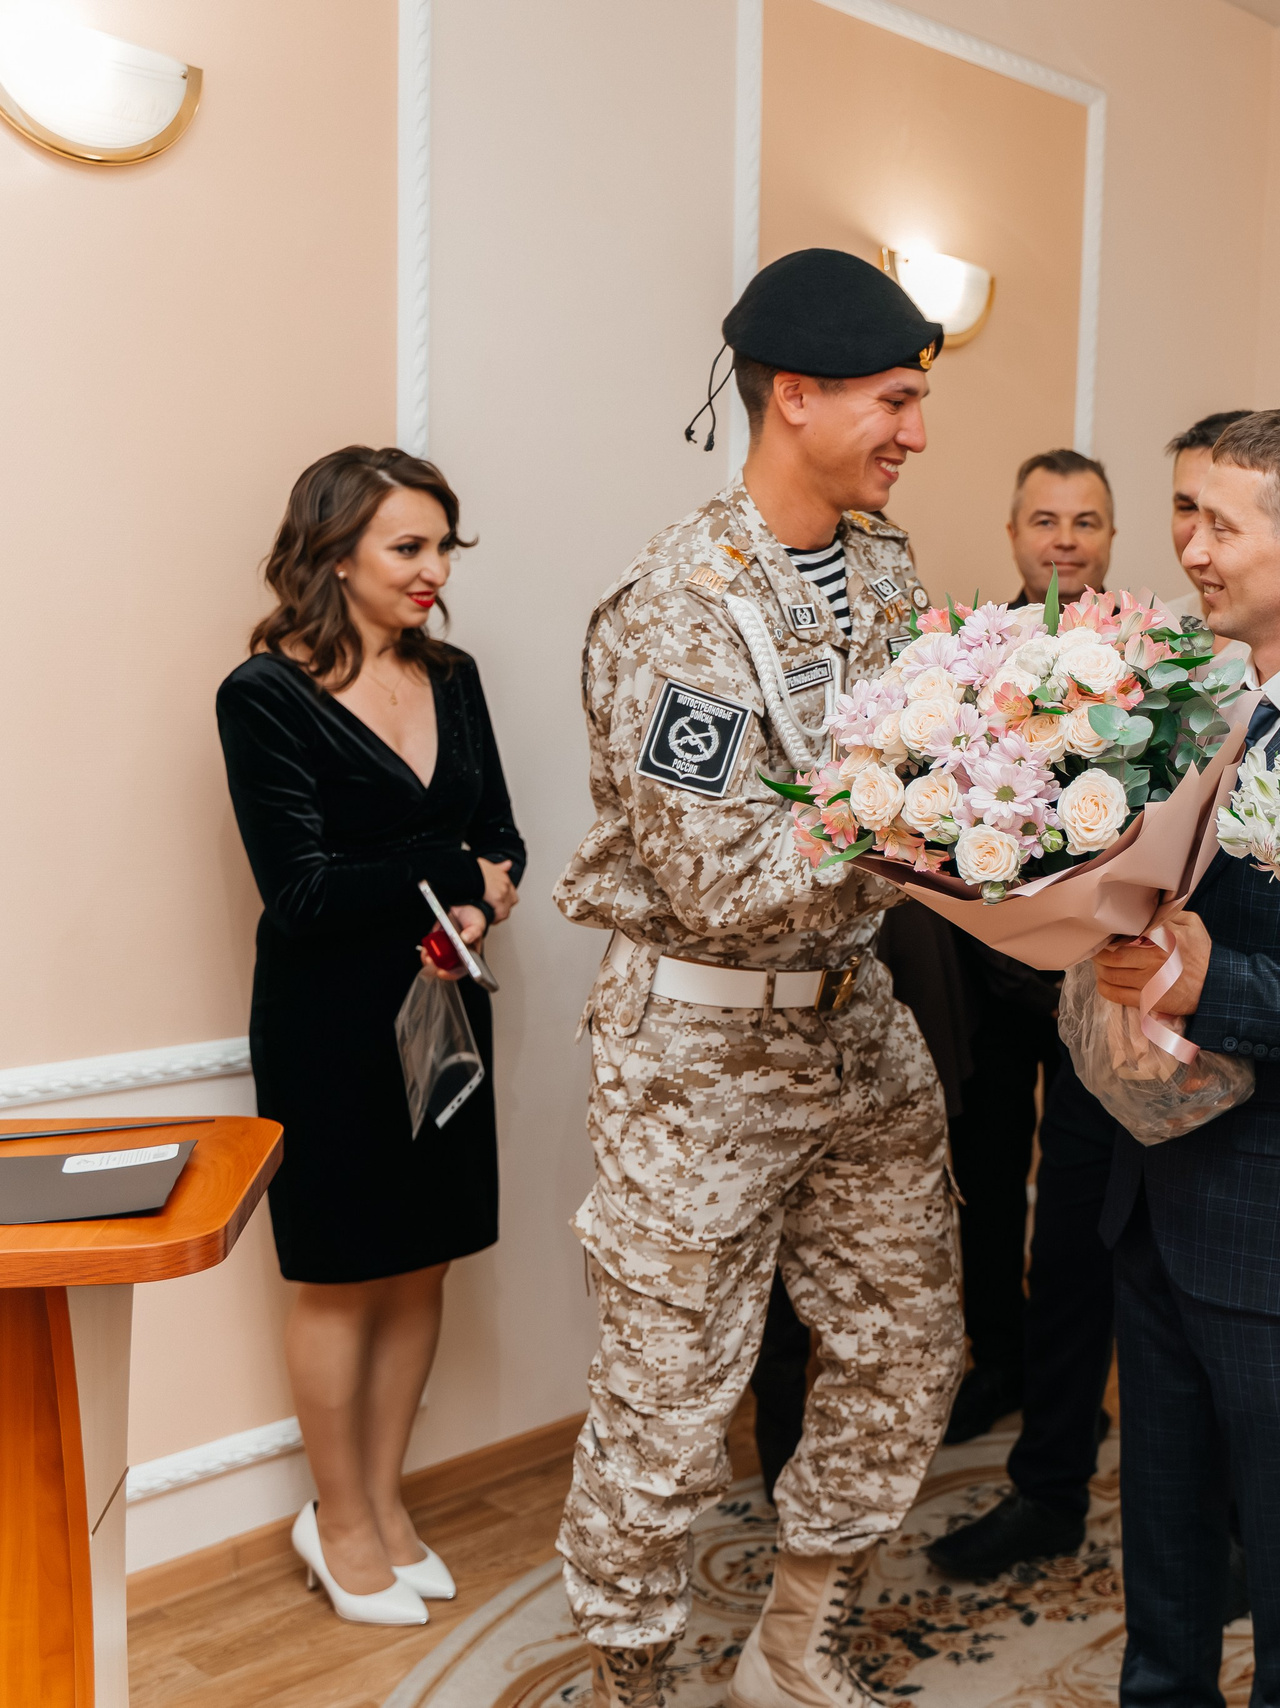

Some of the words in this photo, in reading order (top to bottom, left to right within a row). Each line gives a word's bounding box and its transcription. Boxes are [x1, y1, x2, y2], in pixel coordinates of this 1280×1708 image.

[676, 694, 733, 721] МОТОСТРЕЛКОВЫЕ
[690, 709, 713, 724] ВОЙСКА
[672, 758, 698, 775] РОССИЯ
